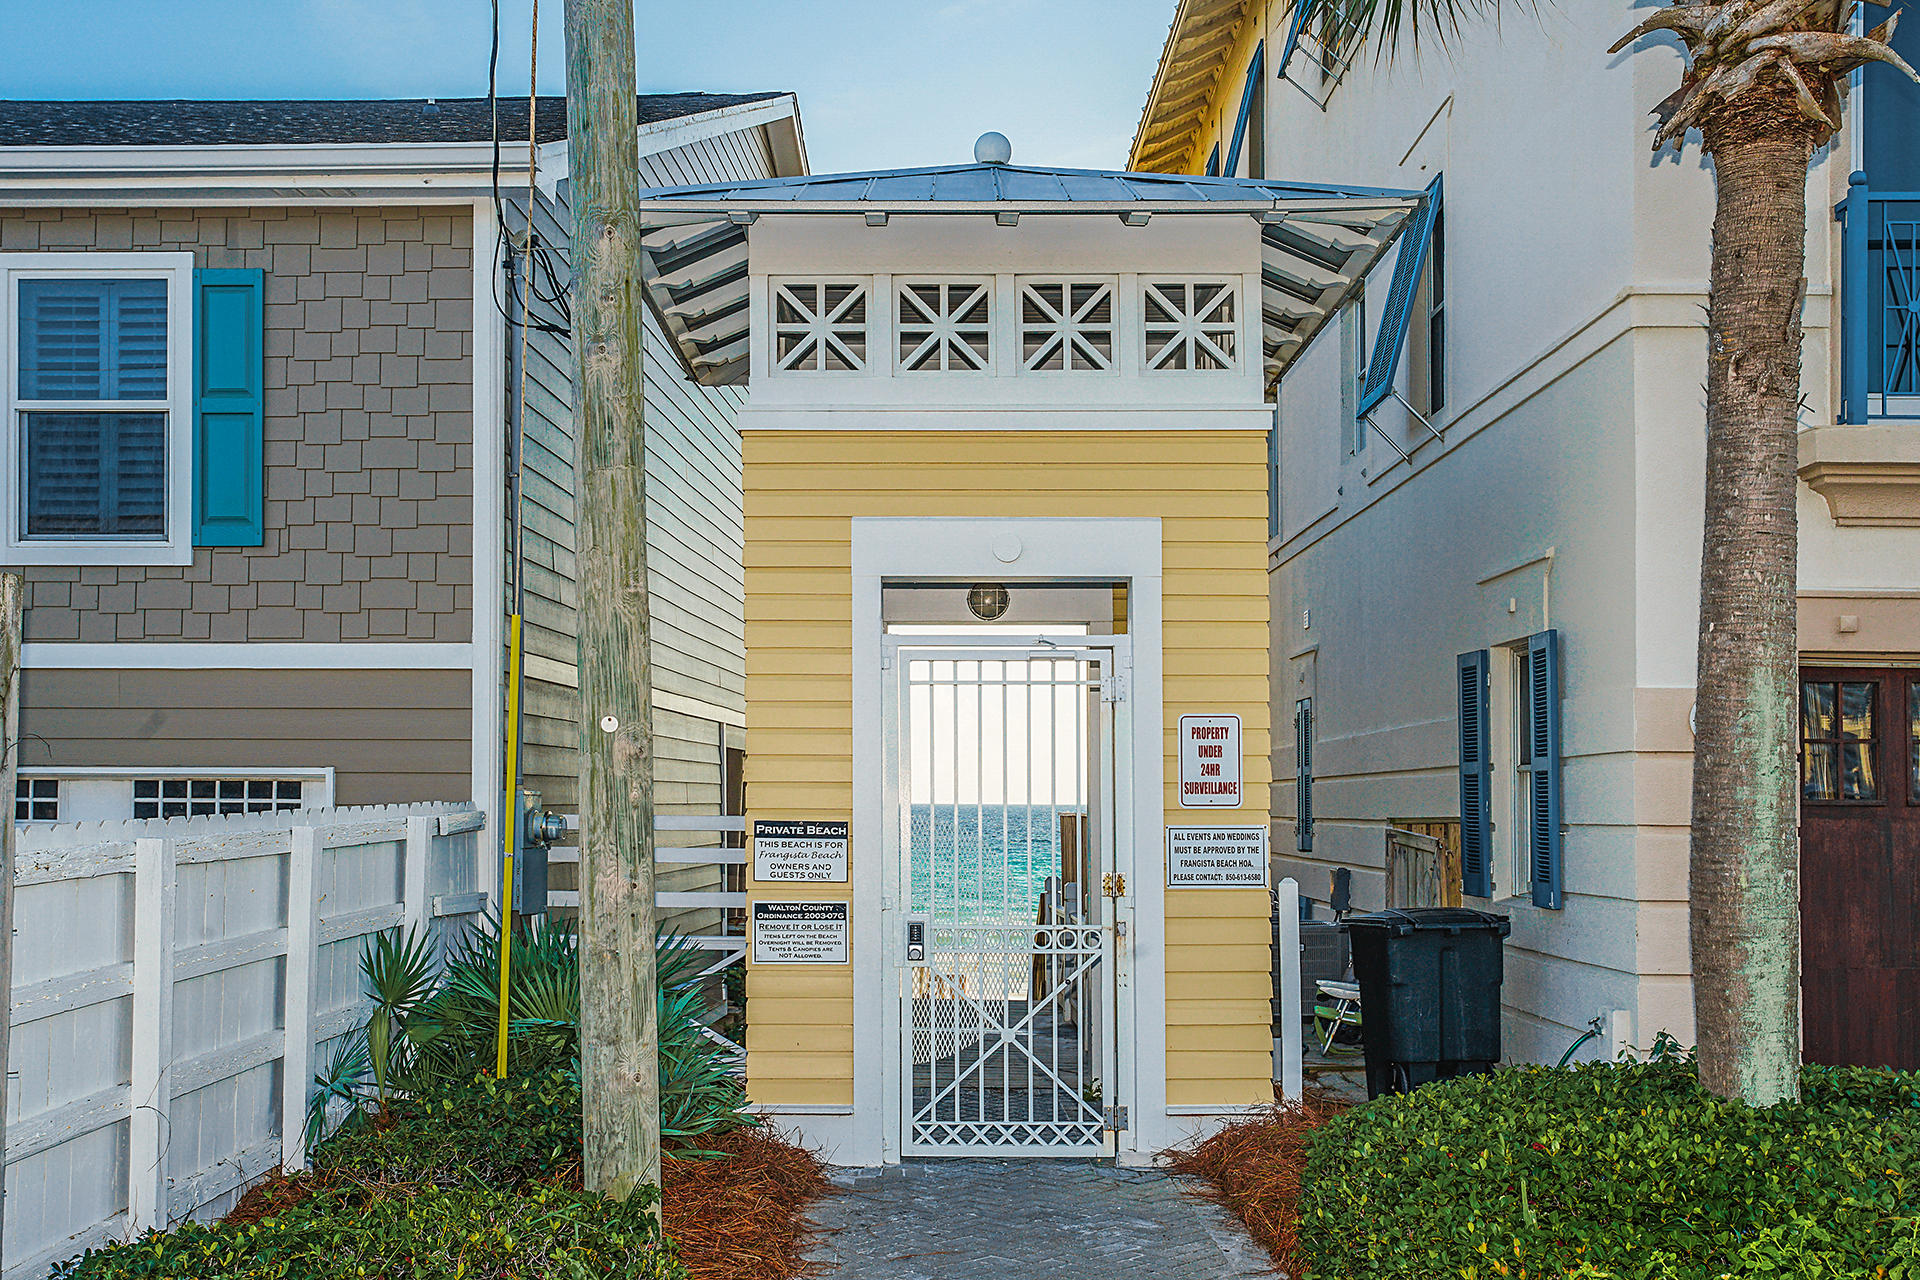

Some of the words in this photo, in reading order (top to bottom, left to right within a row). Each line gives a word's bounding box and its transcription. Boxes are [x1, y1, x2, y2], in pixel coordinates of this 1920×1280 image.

[1192, 727, 1229, 739] PROPERTY
[1198, 745, 1222, 758] UNDER
[1201, 764, 1220, 776] 24HR
[1184, 782, 1237, 794] SURVEILLANCE
[759, 851, 809, 861] Frangista
[811, 851, 843, 859] Beach
